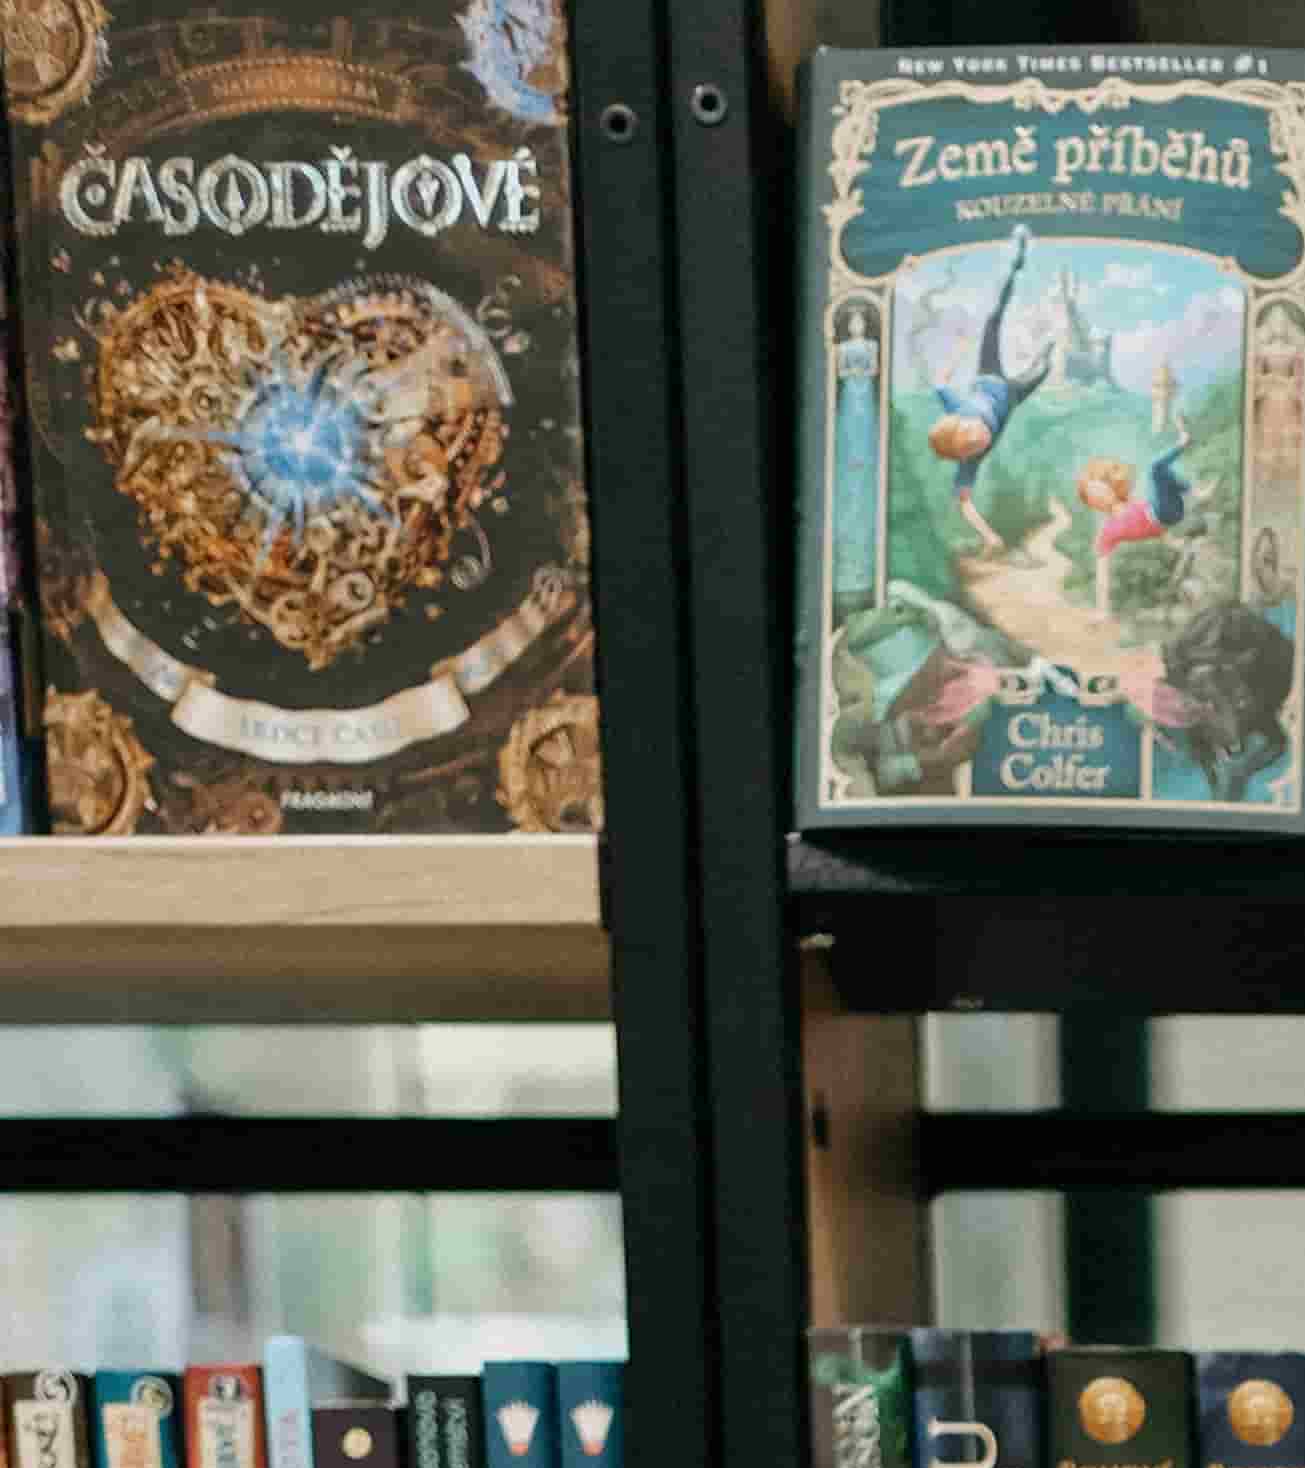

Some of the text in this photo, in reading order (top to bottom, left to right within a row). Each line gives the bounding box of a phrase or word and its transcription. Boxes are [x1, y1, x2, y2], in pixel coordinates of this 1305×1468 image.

[897, 56, 944, 75] NEW
[952, 56, 1009, 74] YORK
[1016, 54, 1083, 74] TIMES
[1090, 54, 1225, 74] BESTSELLER
[894, 125, 1252, 189] Země příběhů
[59, 144, 540, 249] ČASODĚJOVÉ
[1006, 711, 1105, 751] Chris
[1000, 753, 1114, 793] Colfer
